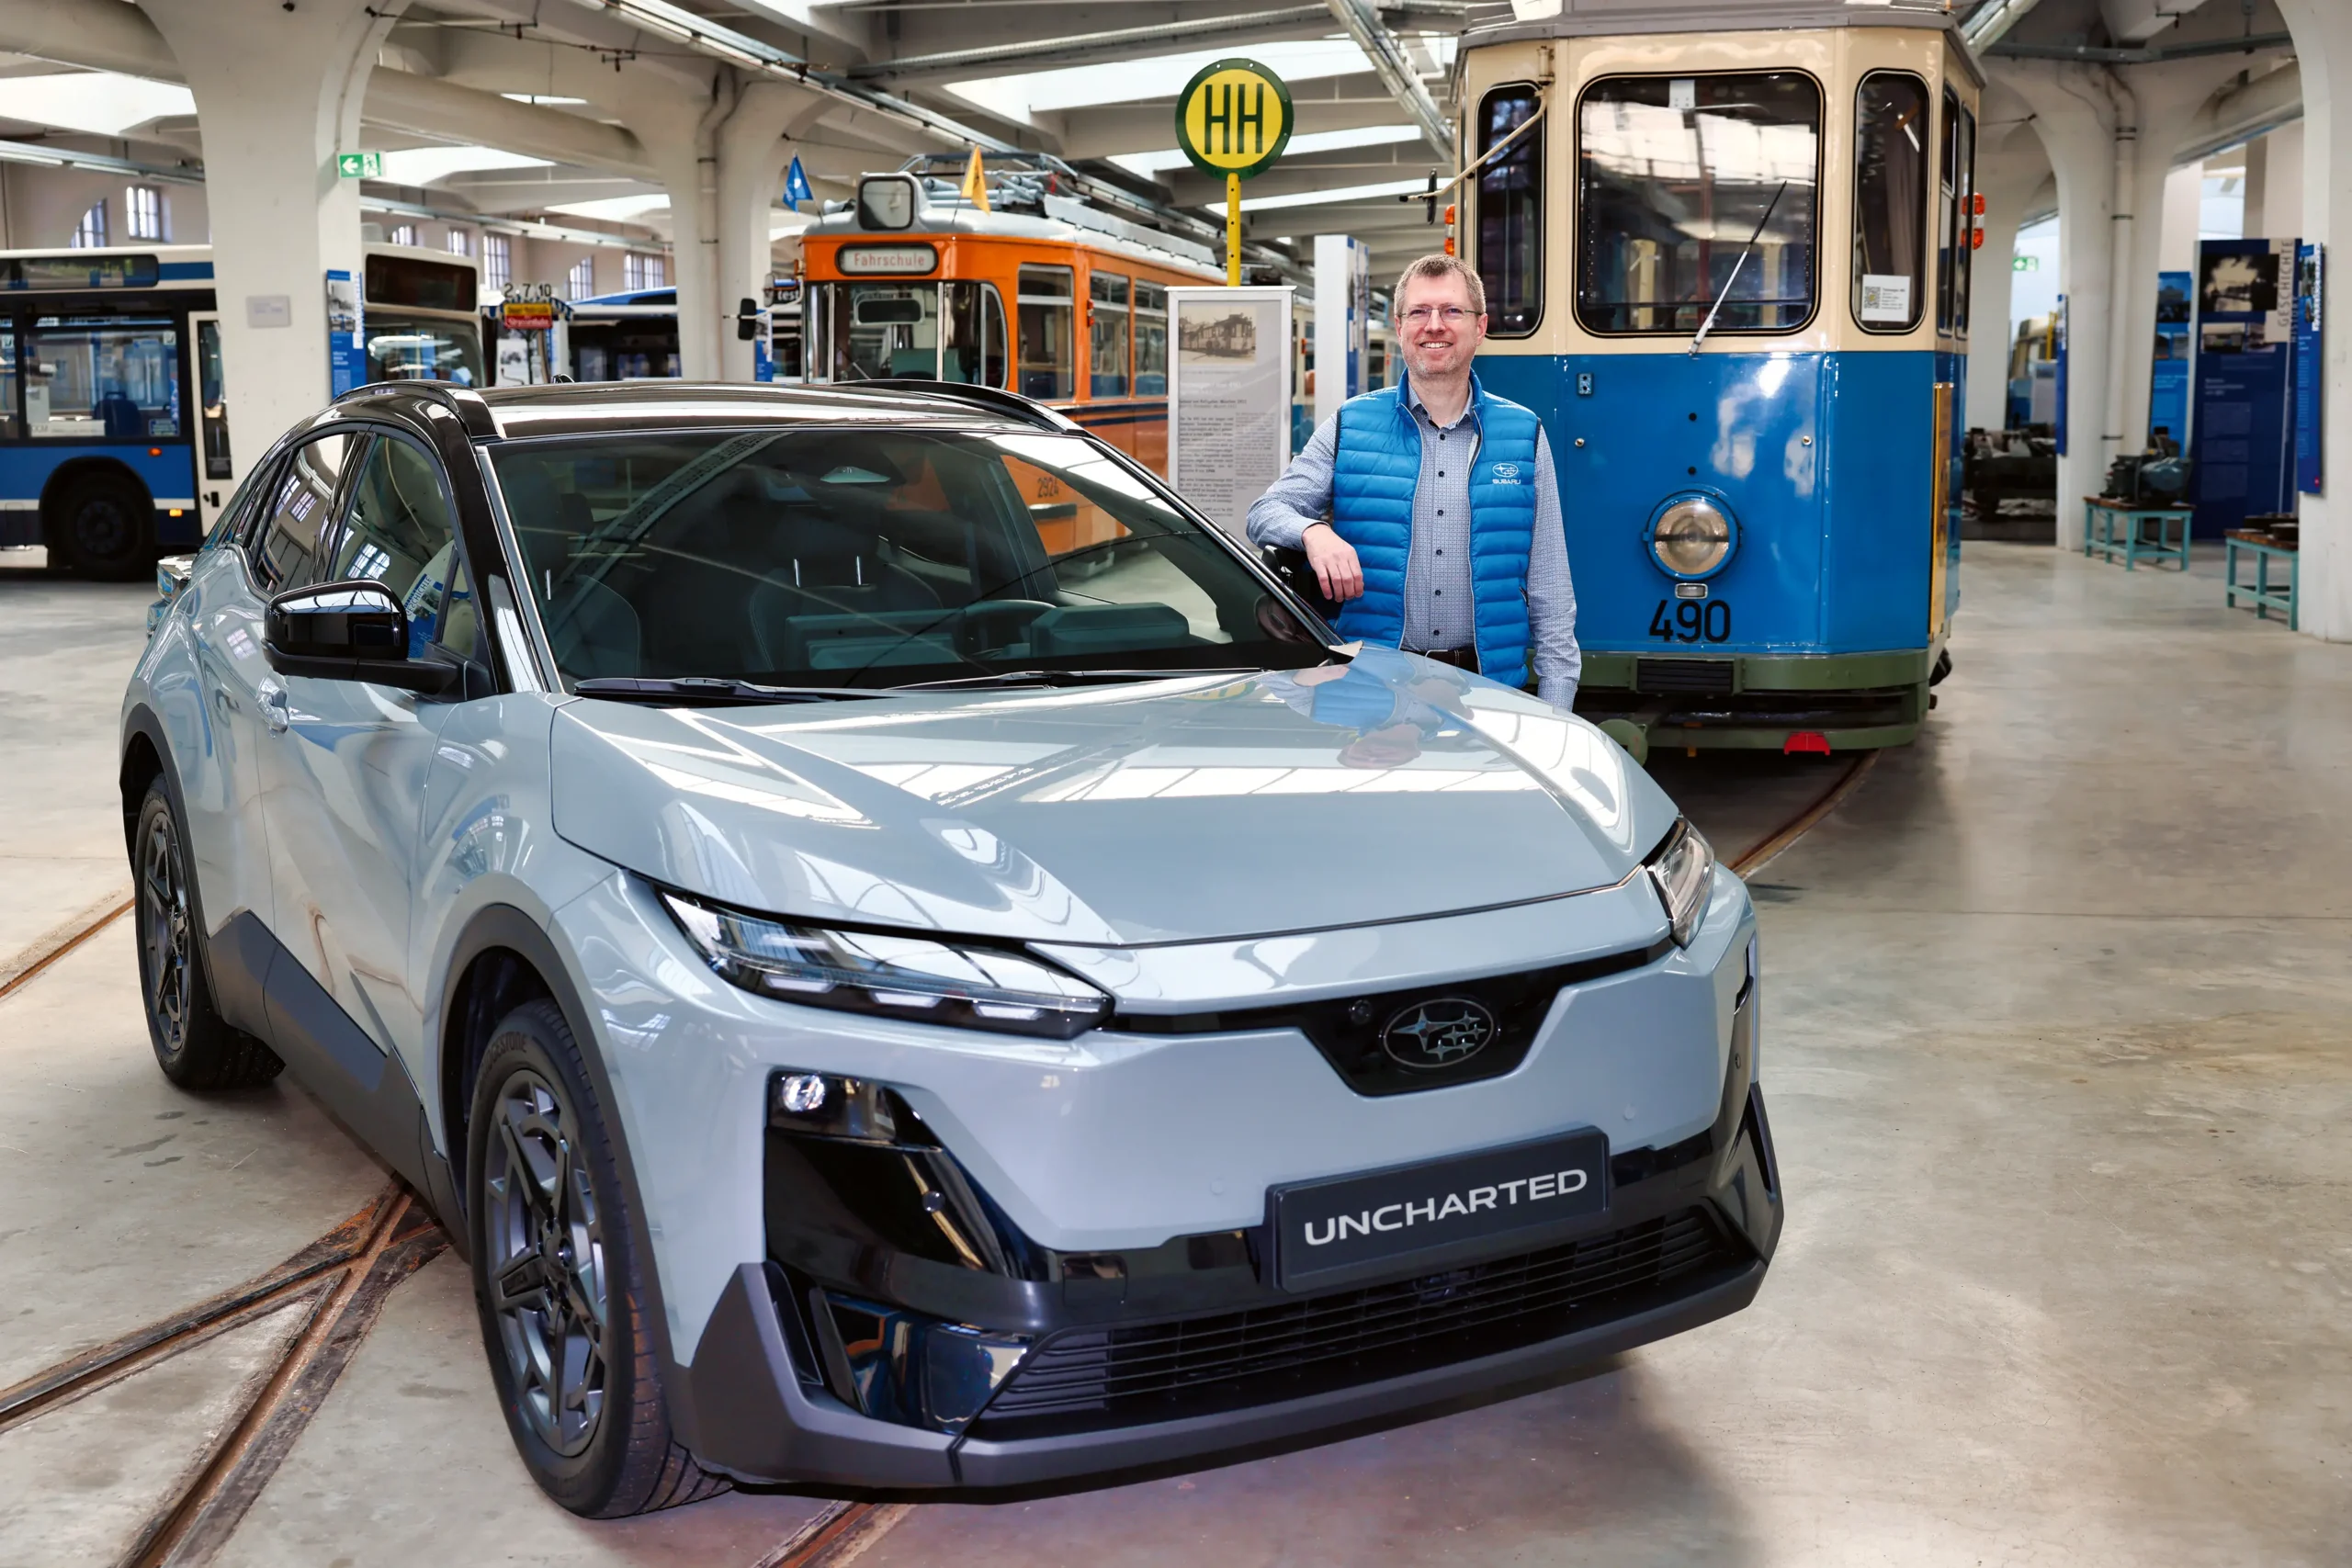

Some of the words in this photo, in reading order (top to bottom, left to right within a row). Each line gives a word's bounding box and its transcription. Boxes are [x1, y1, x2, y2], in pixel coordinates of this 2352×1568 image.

[1204, 83, 1263, 154] HH
[854, 253, 925, 267] Fahrschule
[2278, 239, 2294, 327] GESCHICHTE
[504, 283, 514, 298] 2
[523, 283, 531, 298] 7
[539, 284, 551, 297] 10
[1648, 599, 1731, 643] 490
[1304, 1168, 1588, 1247] UNCHARTED
